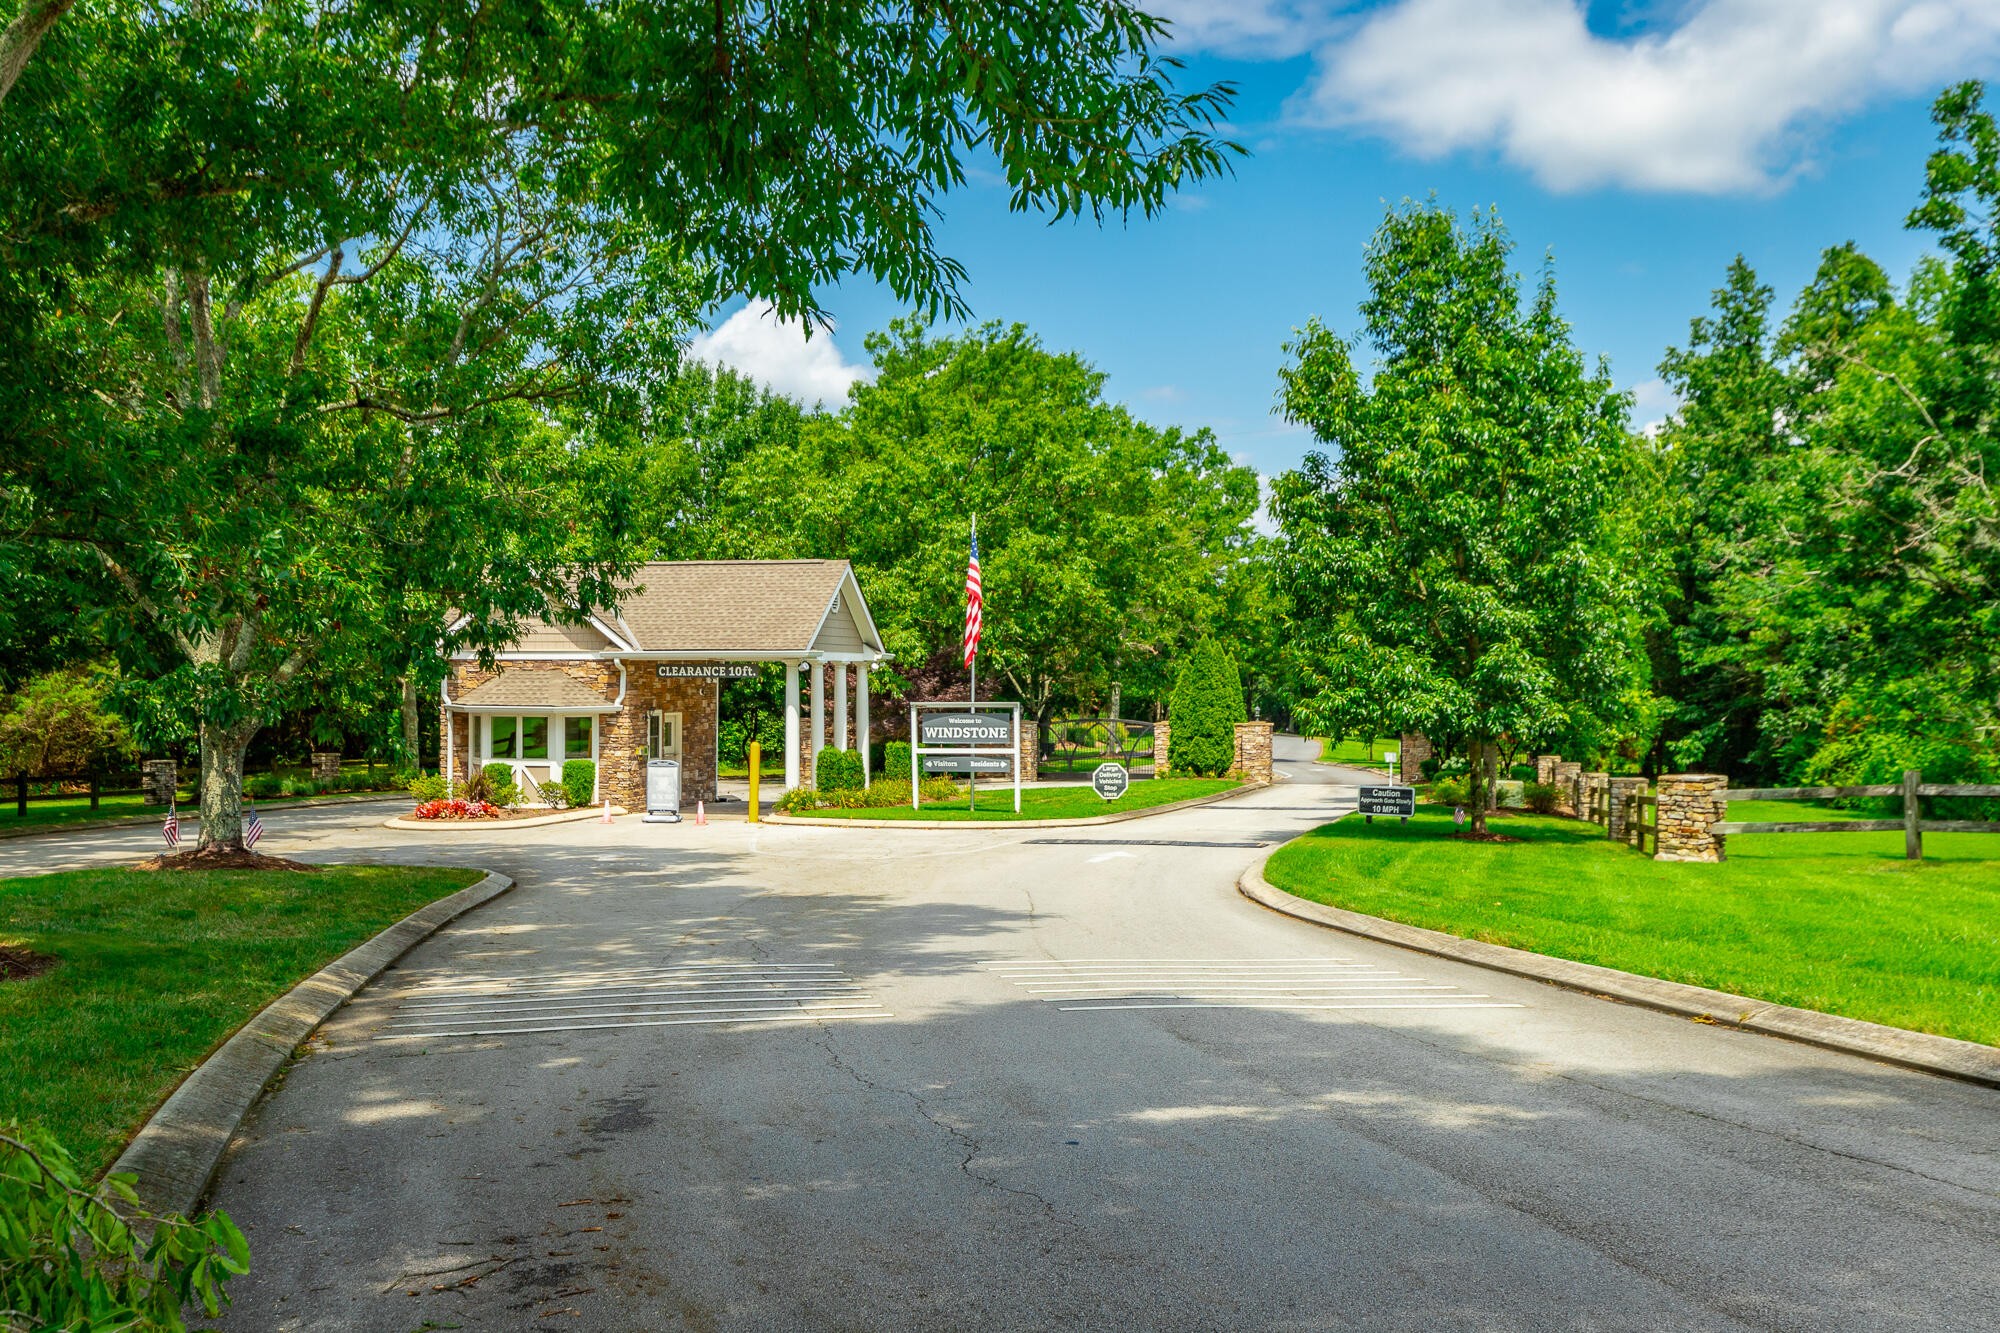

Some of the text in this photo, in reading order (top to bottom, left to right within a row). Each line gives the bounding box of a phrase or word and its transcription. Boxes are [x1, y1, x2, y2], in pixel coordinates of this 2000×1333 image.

[658, 665, 757, 677] CLEARANCE 10ft.
[925, 727, 1008, 738] WINDSTONE
[1372, 789, 1400, 797] Caution
